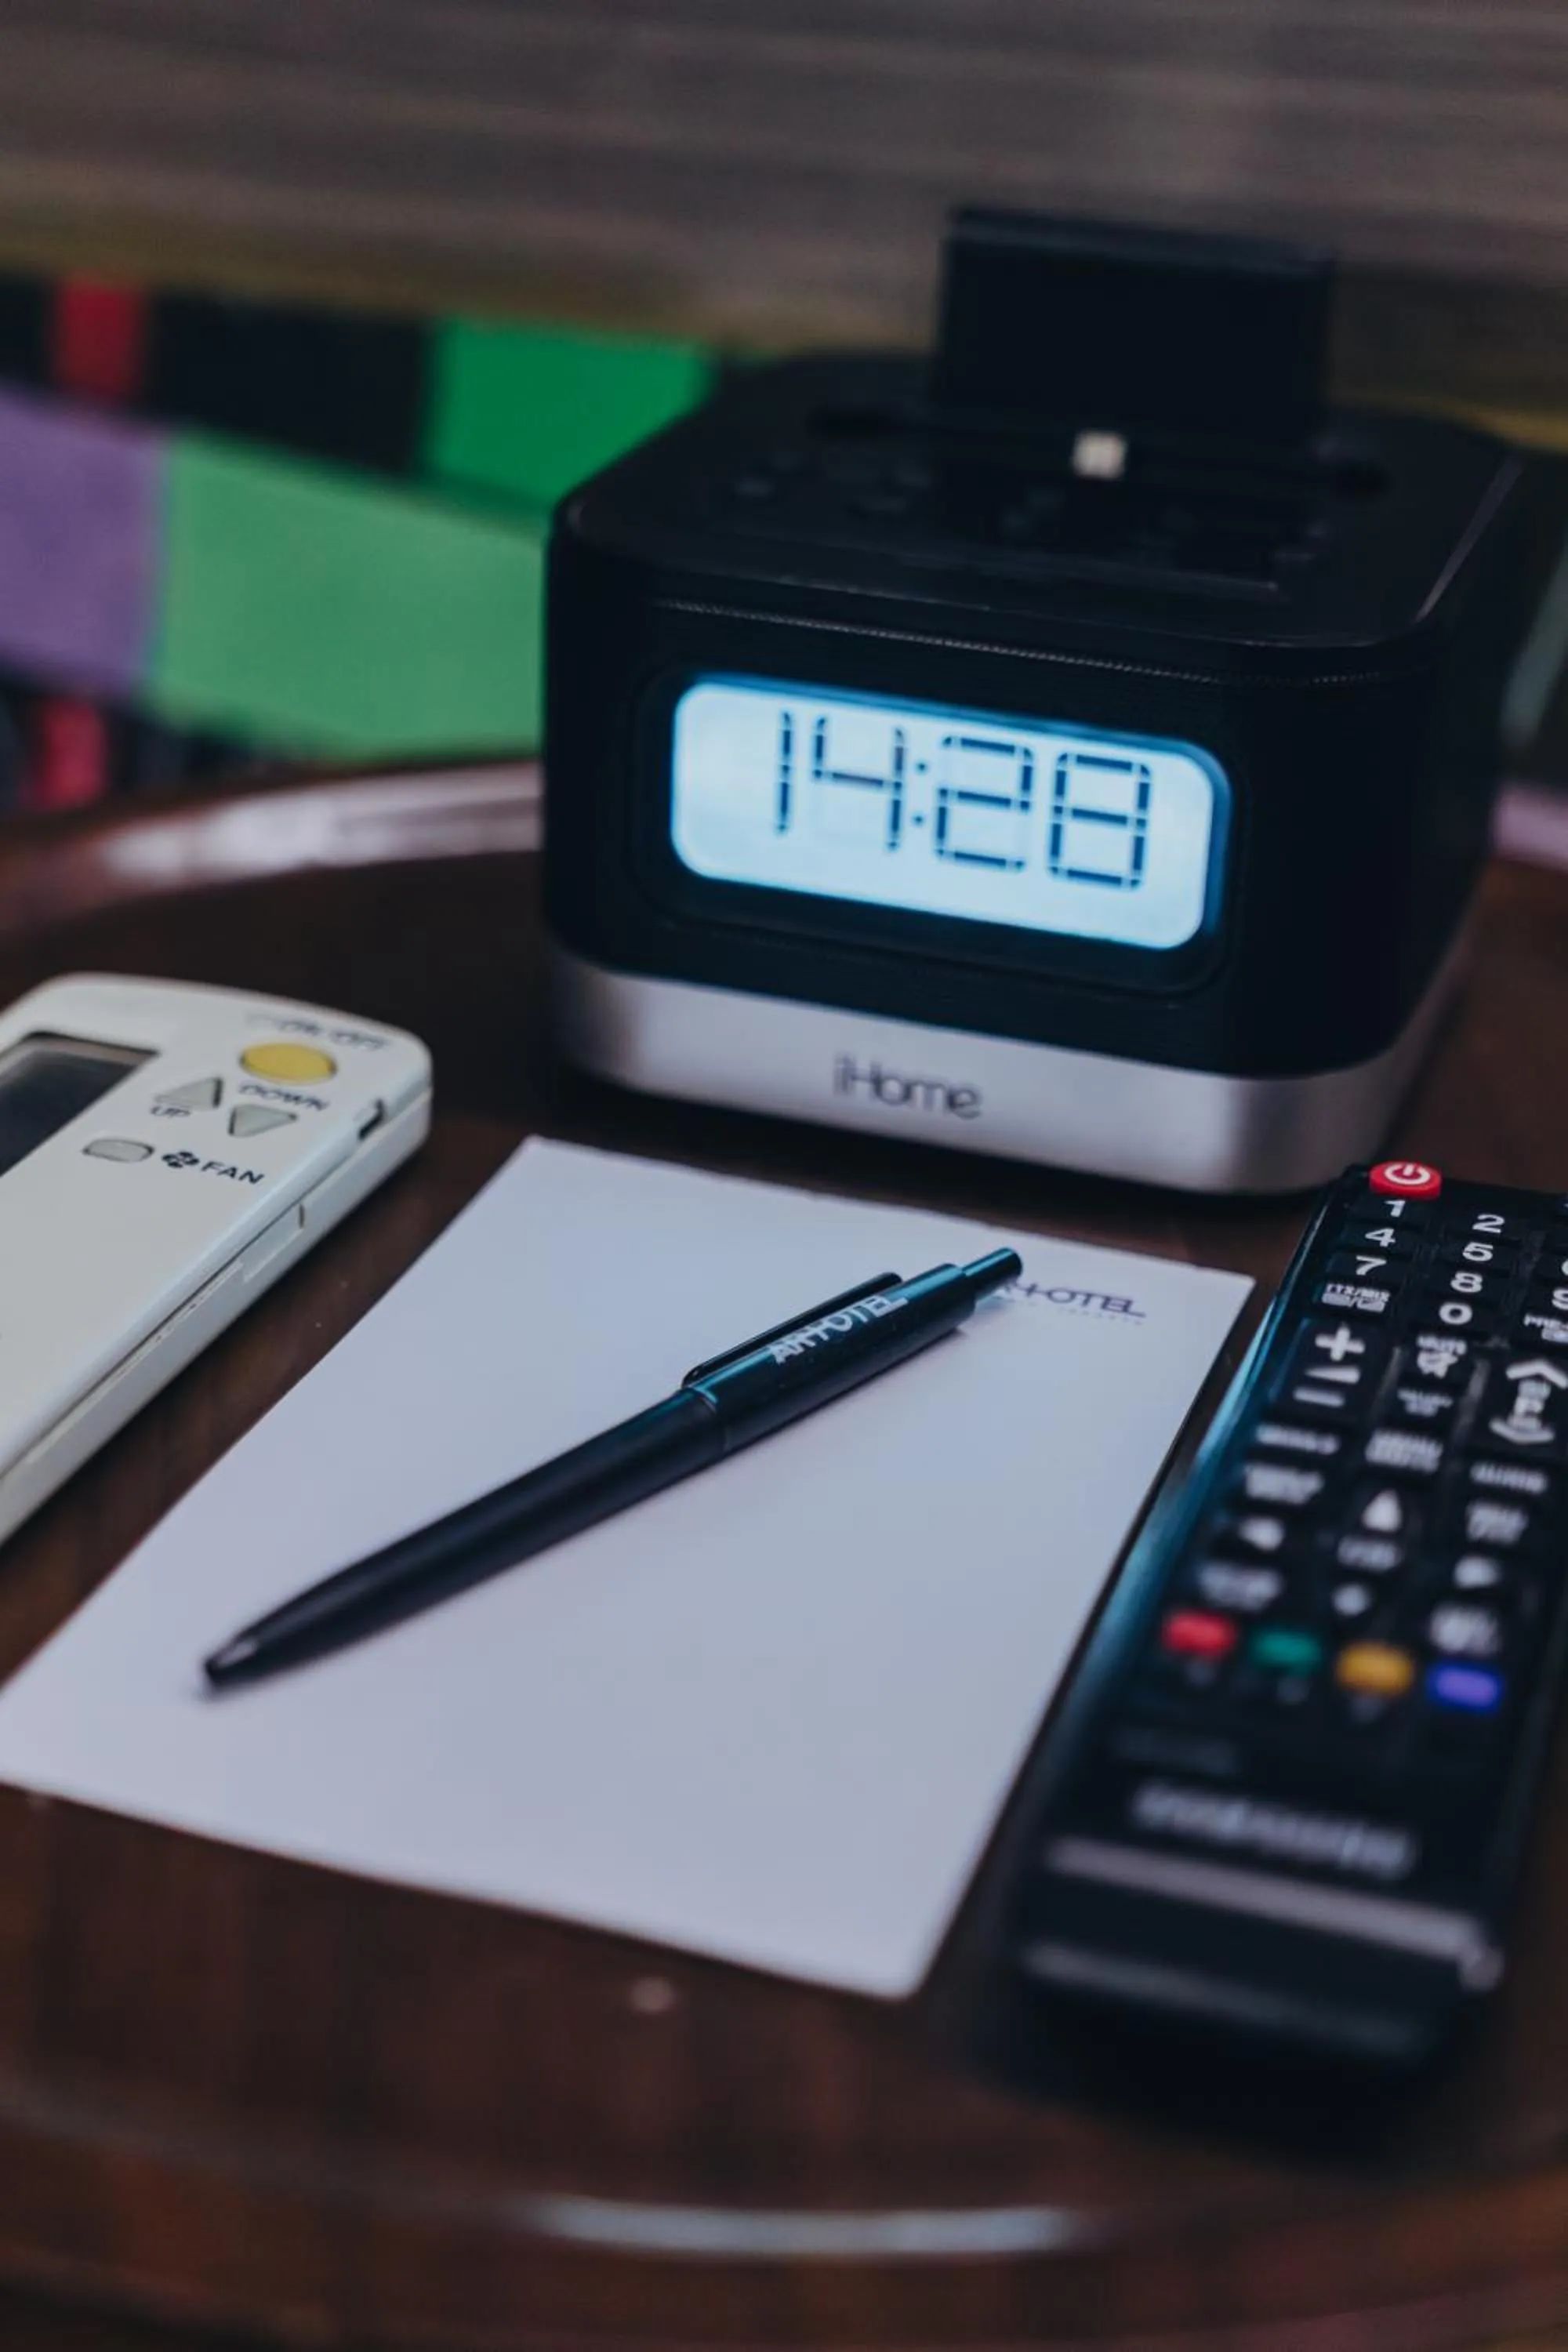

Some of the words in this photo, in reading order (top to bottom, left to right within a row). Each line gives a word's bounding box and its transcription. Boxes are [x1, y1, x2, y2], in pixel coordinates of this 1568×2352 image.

[775, 710, 1151, 891] 14:28
[239, 1083, 329, 1112] DOWN
[833, 1054, 983, 1120] iHome
[150, 1105, 191, 1119] UP
[201, 1160, 265, 1185] FAN
[1385, 1200, 1406, 1217] 1
[1472, 1214, 1505, 1233] 2
[1364, 1228, 1396, 1247] 4
[1462, 1242, 1494, 1261] 5
[1356, 1255, 1387, 1276] 7
[1450, 1272, 1483, 1293] 8
